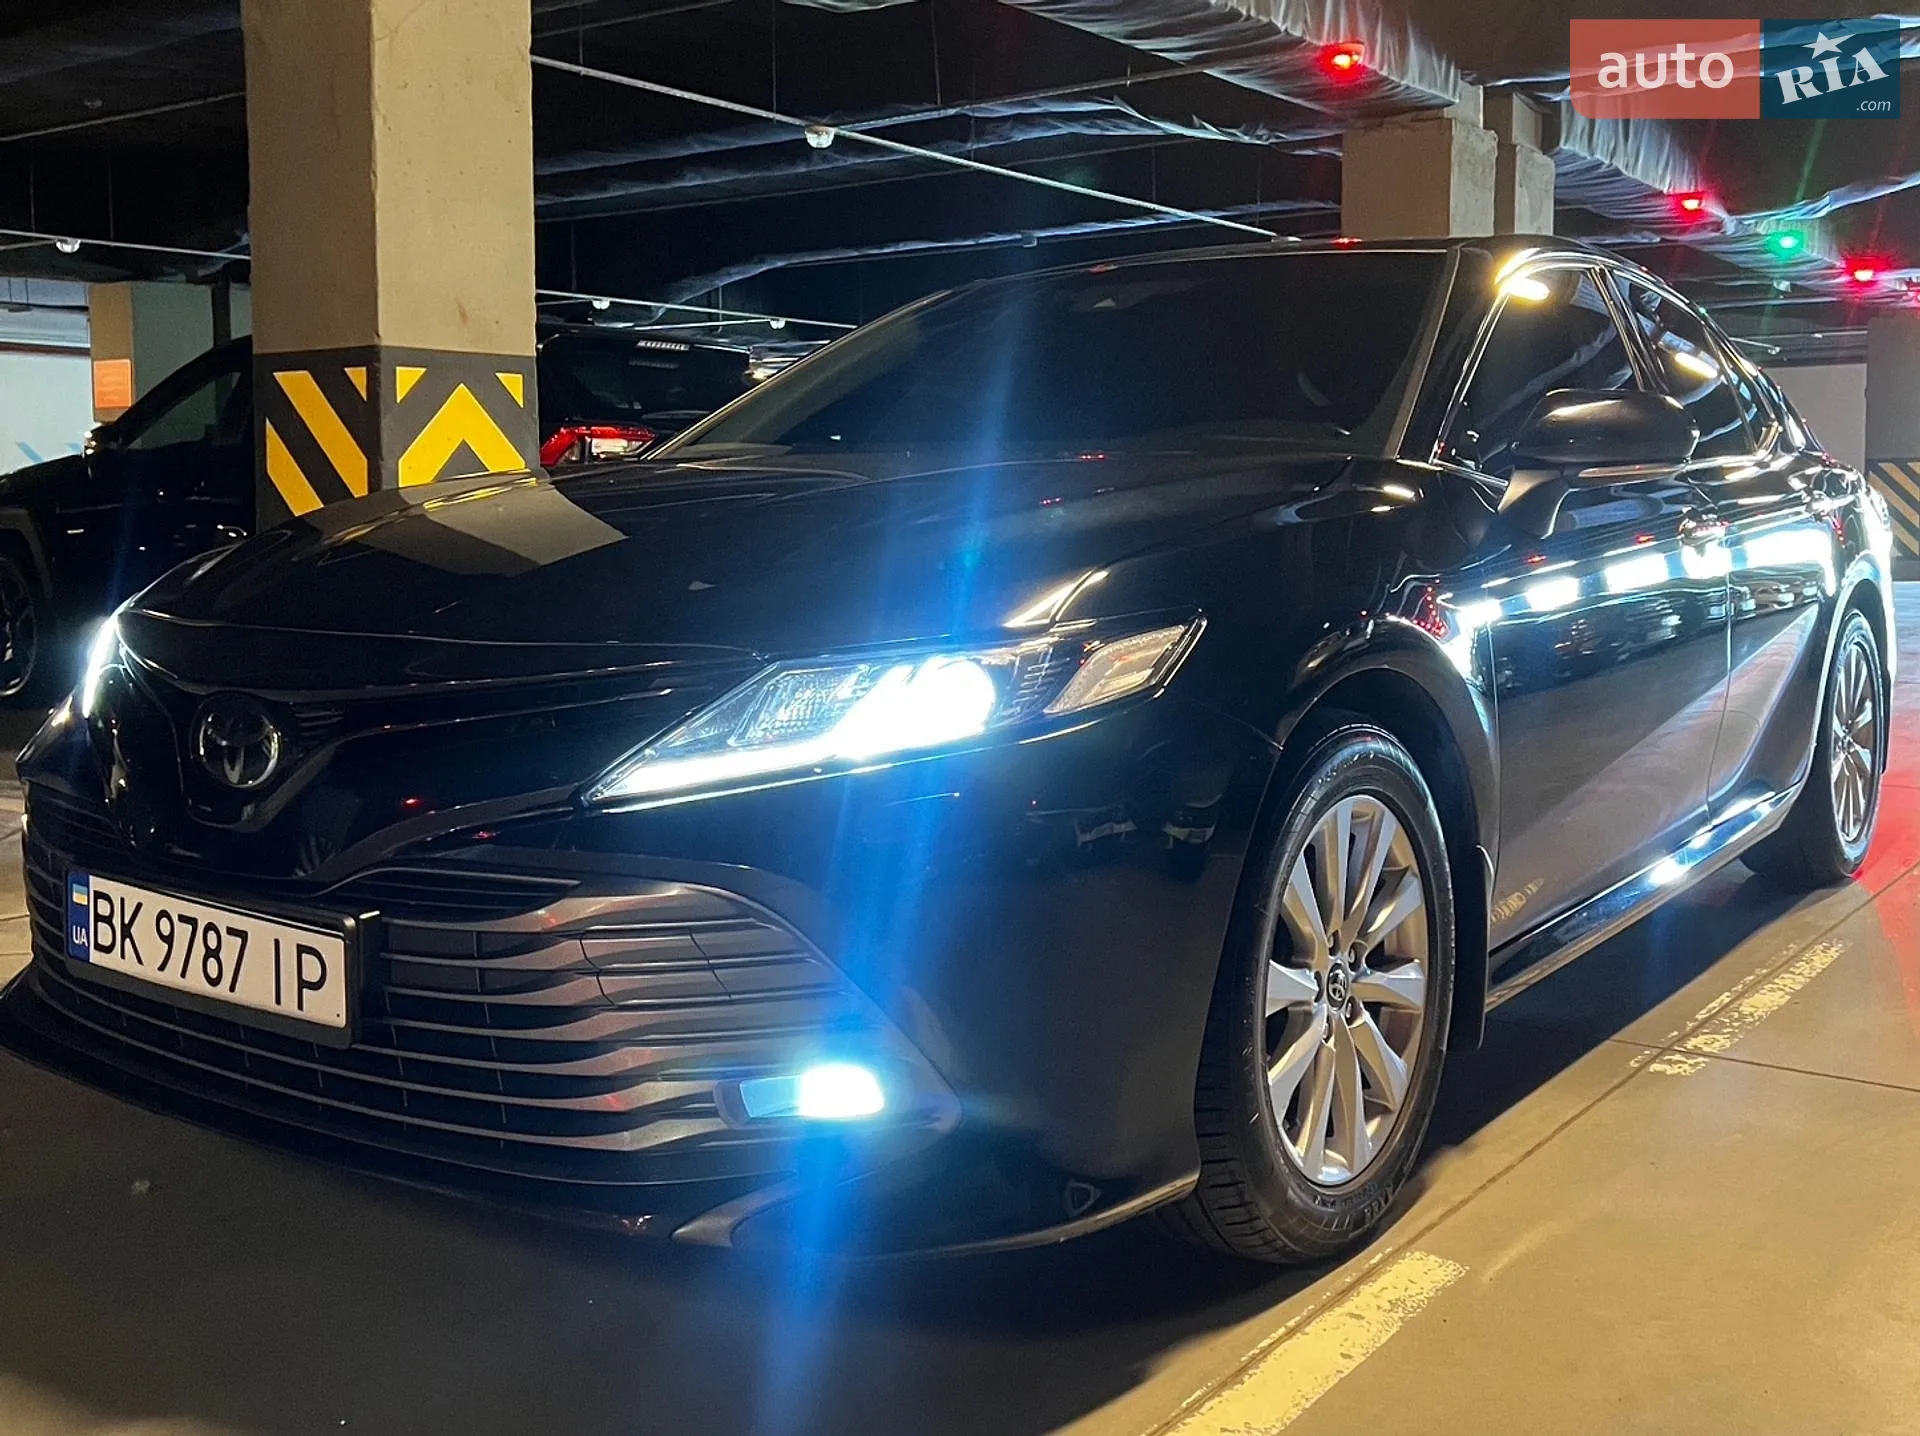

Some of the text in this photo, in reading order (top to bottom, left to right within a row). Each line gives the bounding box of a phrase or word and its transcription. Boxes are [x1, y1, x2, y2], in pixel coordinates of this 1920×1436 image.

[72, 924, 89, 947] UA
[93, 889, 327, 1012] BK 9787 IP
